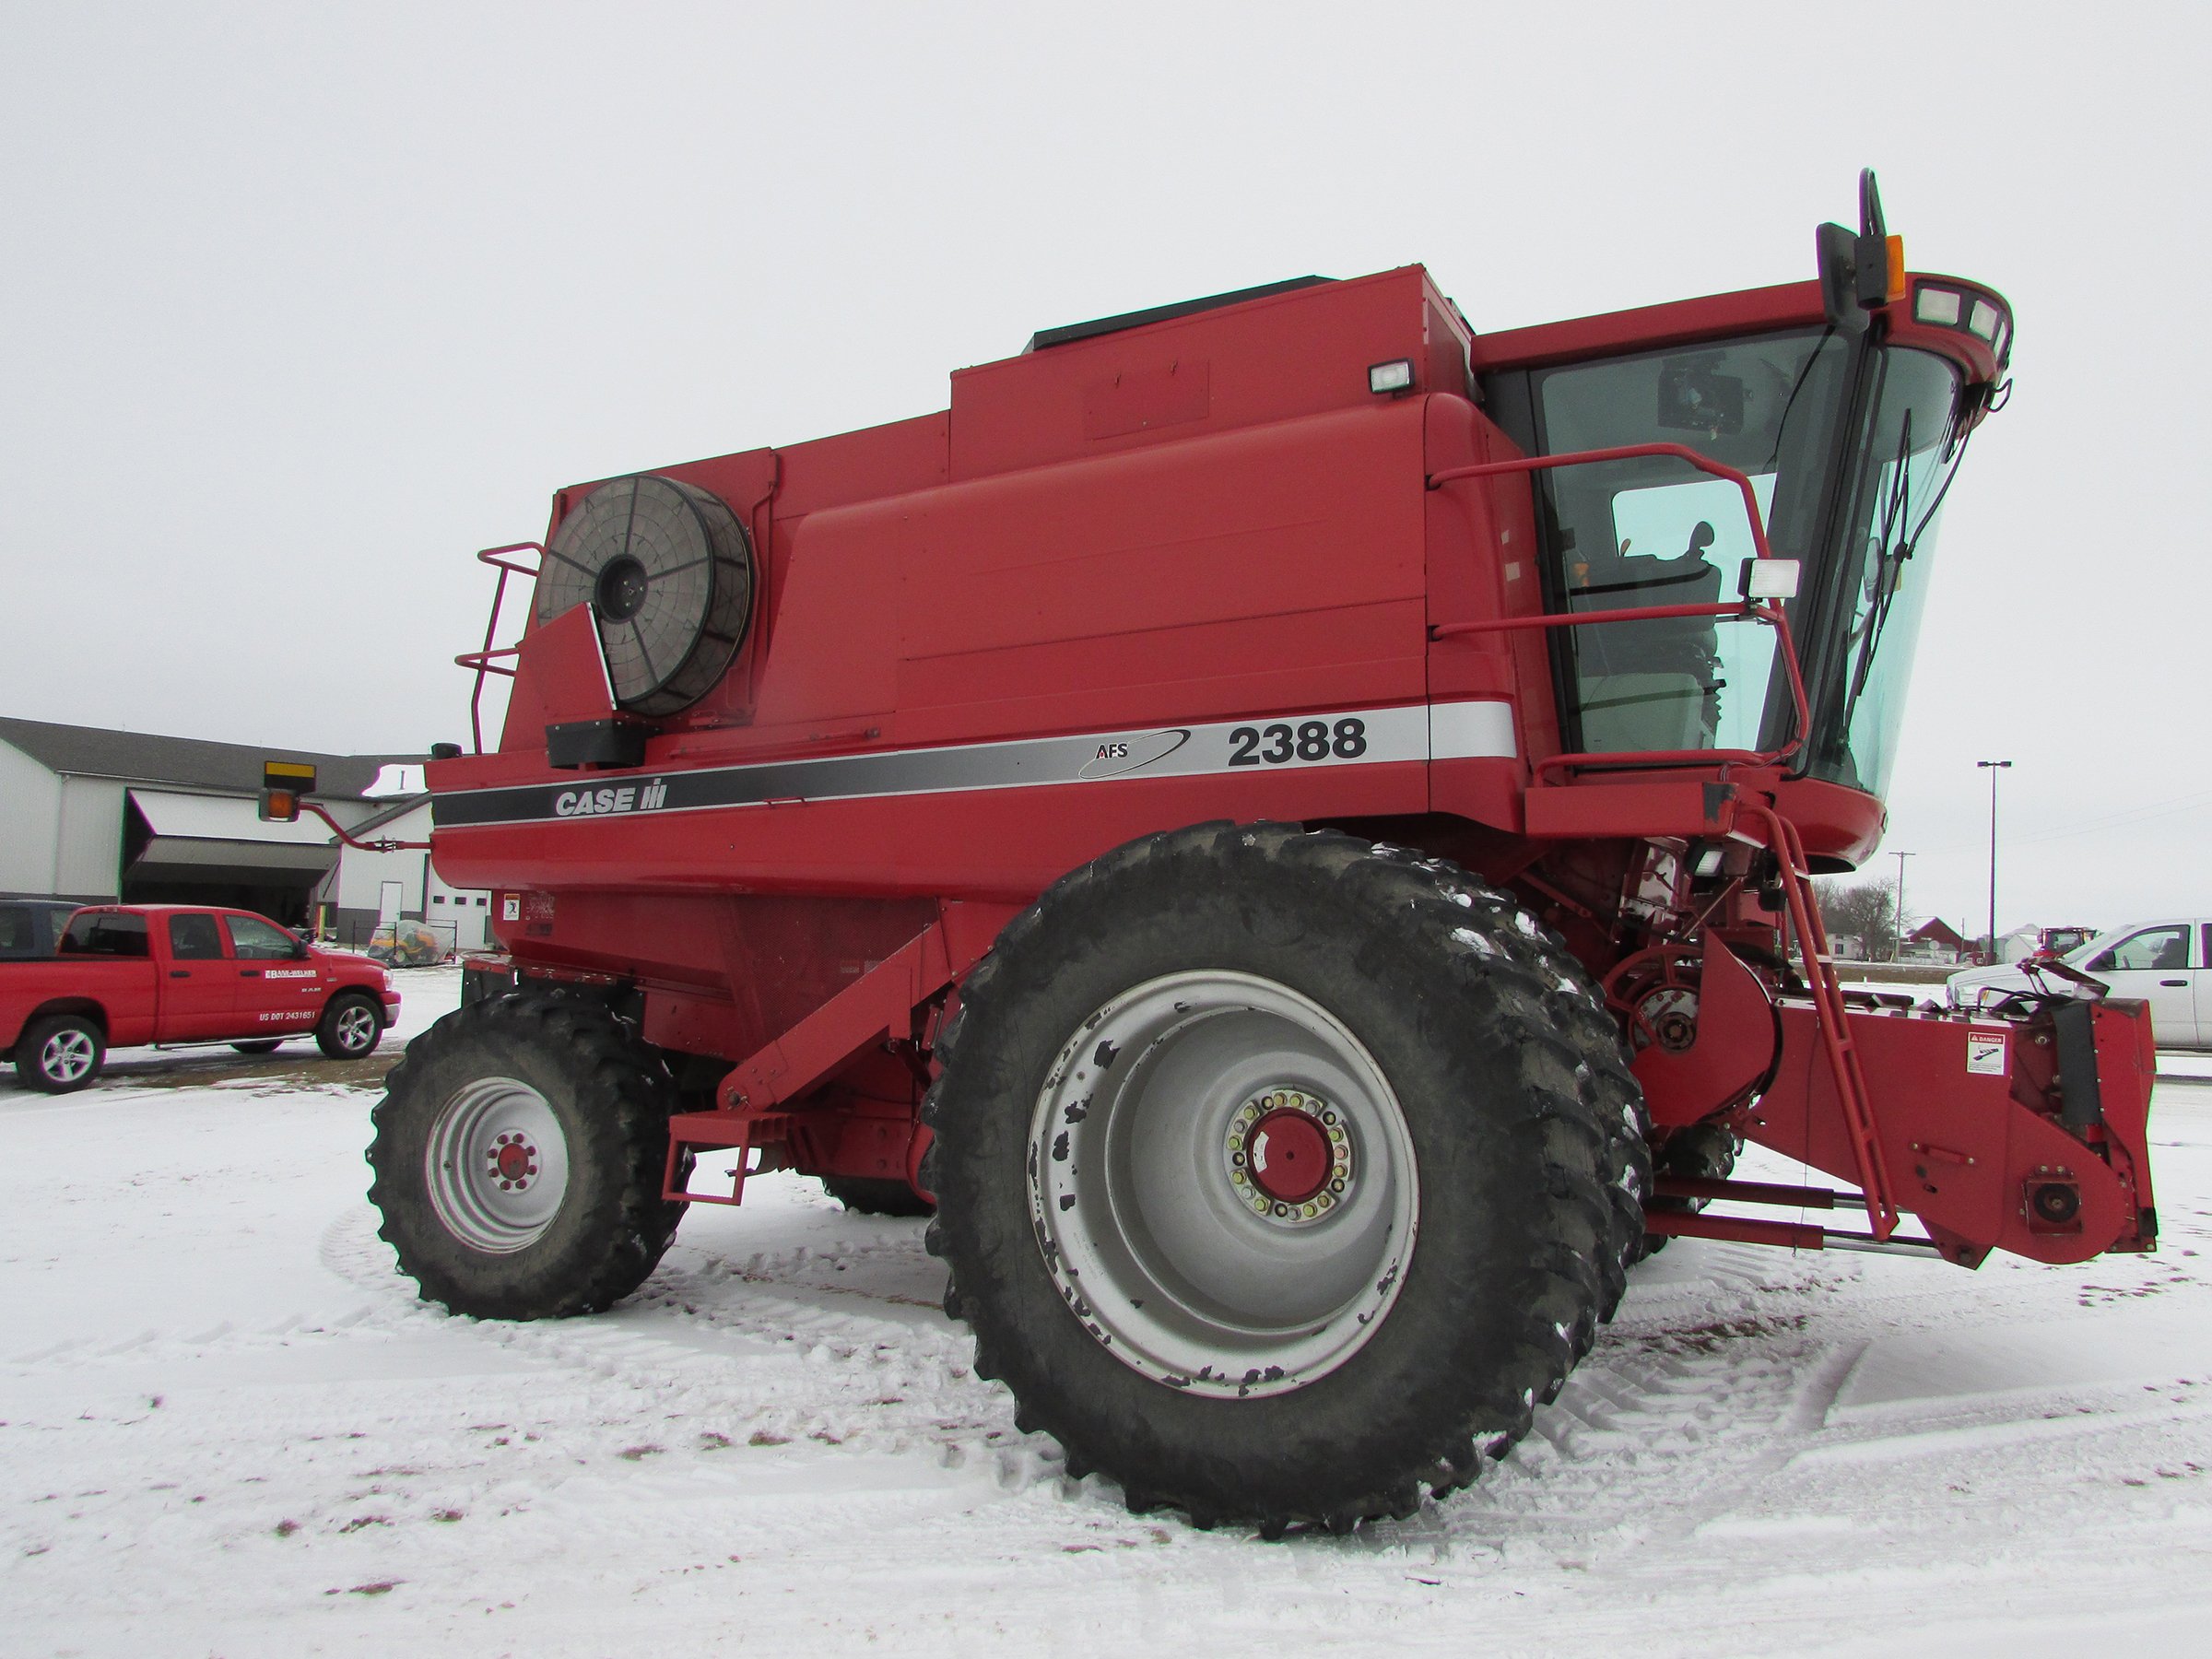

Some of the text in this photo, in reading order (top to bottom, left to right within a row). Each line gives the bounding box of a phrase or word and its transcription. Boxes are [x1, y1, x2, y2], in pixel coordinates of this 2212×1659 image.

[1095, 743, 1128, 759] AFS
[1228, 717, 1367, 767] 2388
[556, 787, 637, 816] CASE
[259, 1011, 316, 1021] US DOT 2431651
